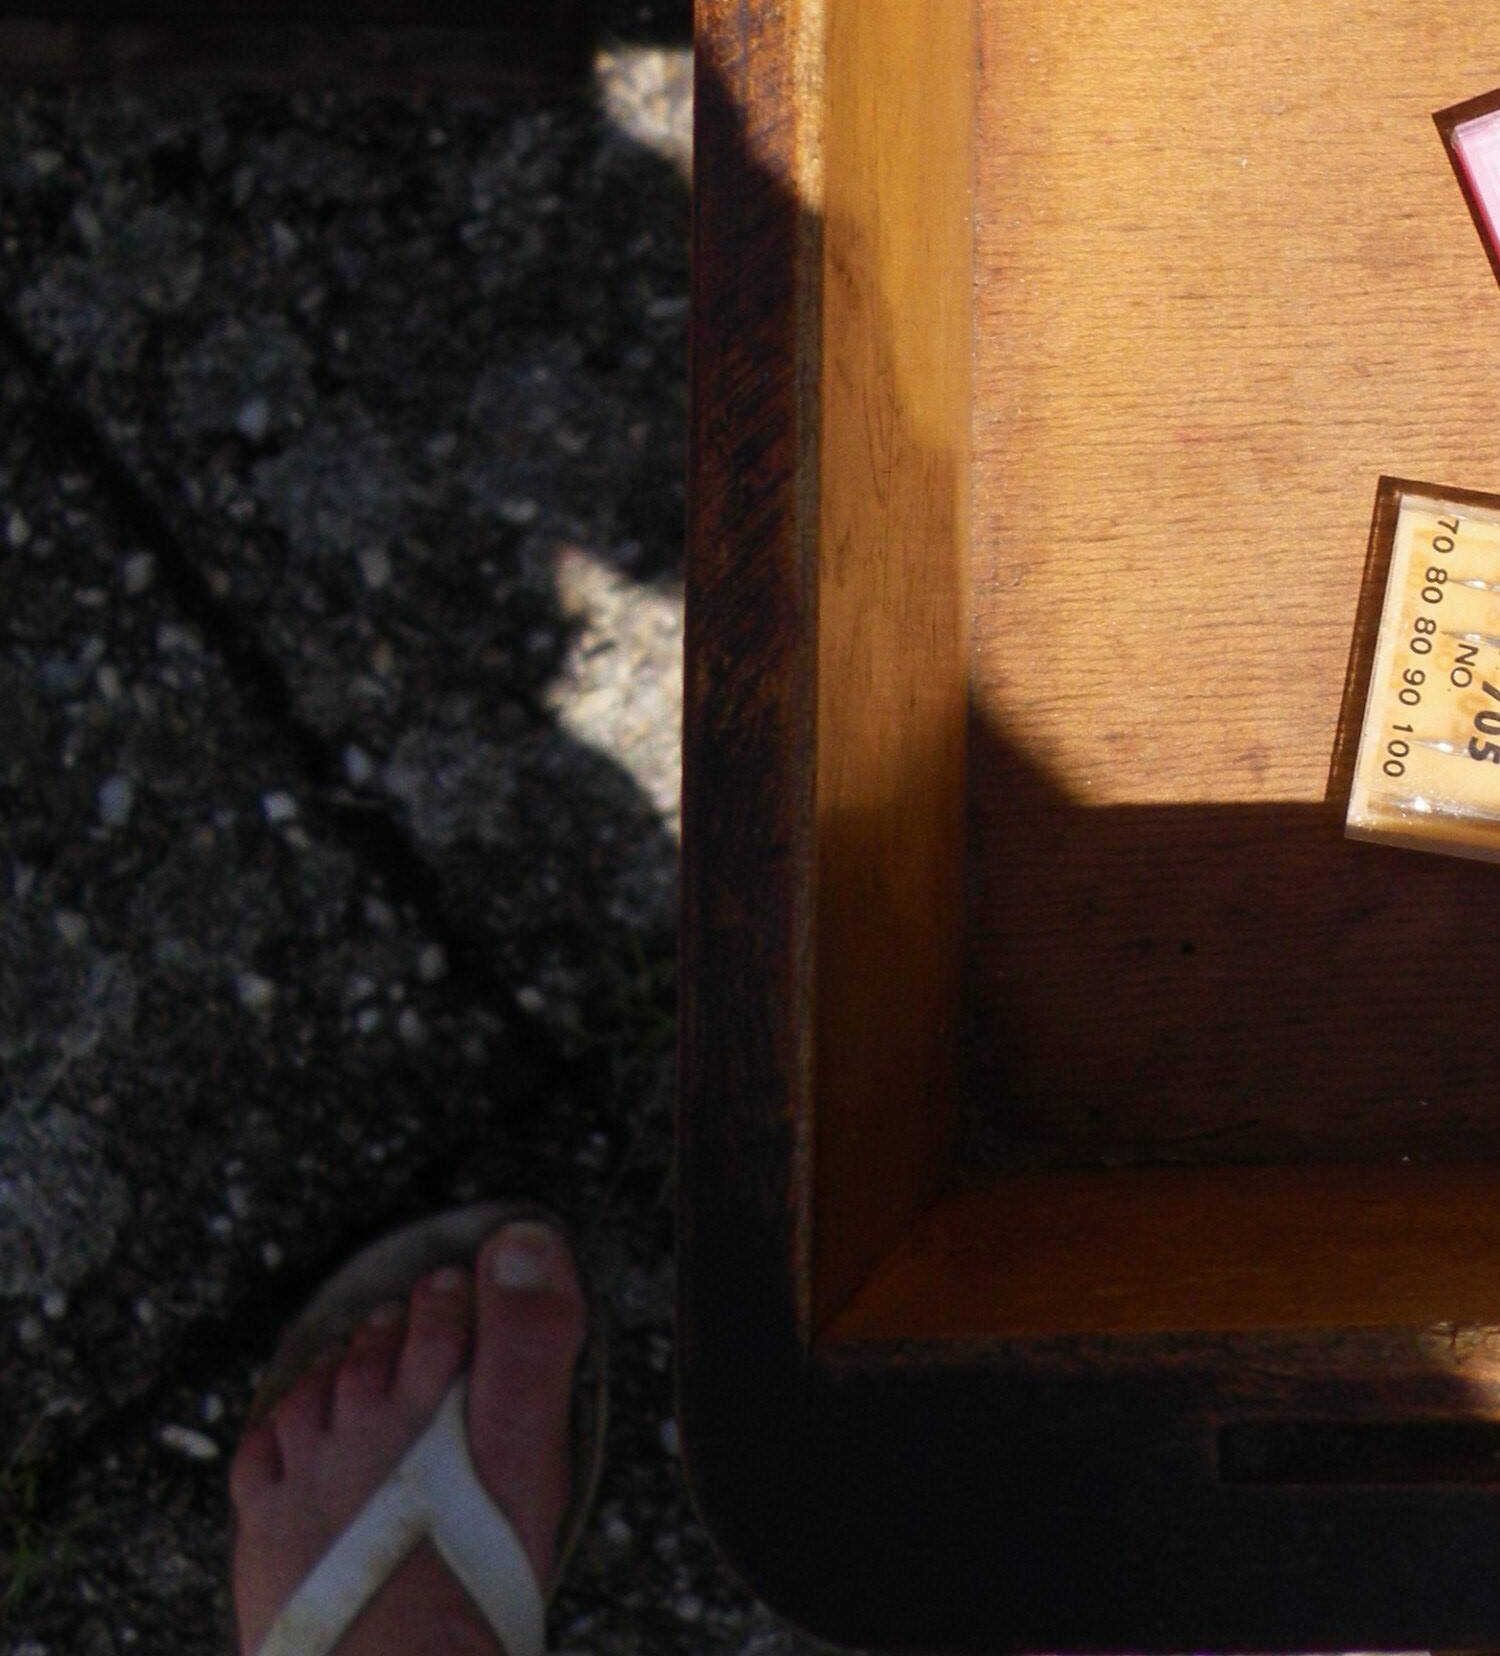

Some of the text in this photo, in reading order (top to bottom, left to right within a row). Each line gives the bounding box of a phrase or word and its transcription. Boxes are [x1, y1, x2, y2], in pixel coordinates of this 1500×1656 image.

[1382, 518, 1460, 778] 70 80 80 90 100
